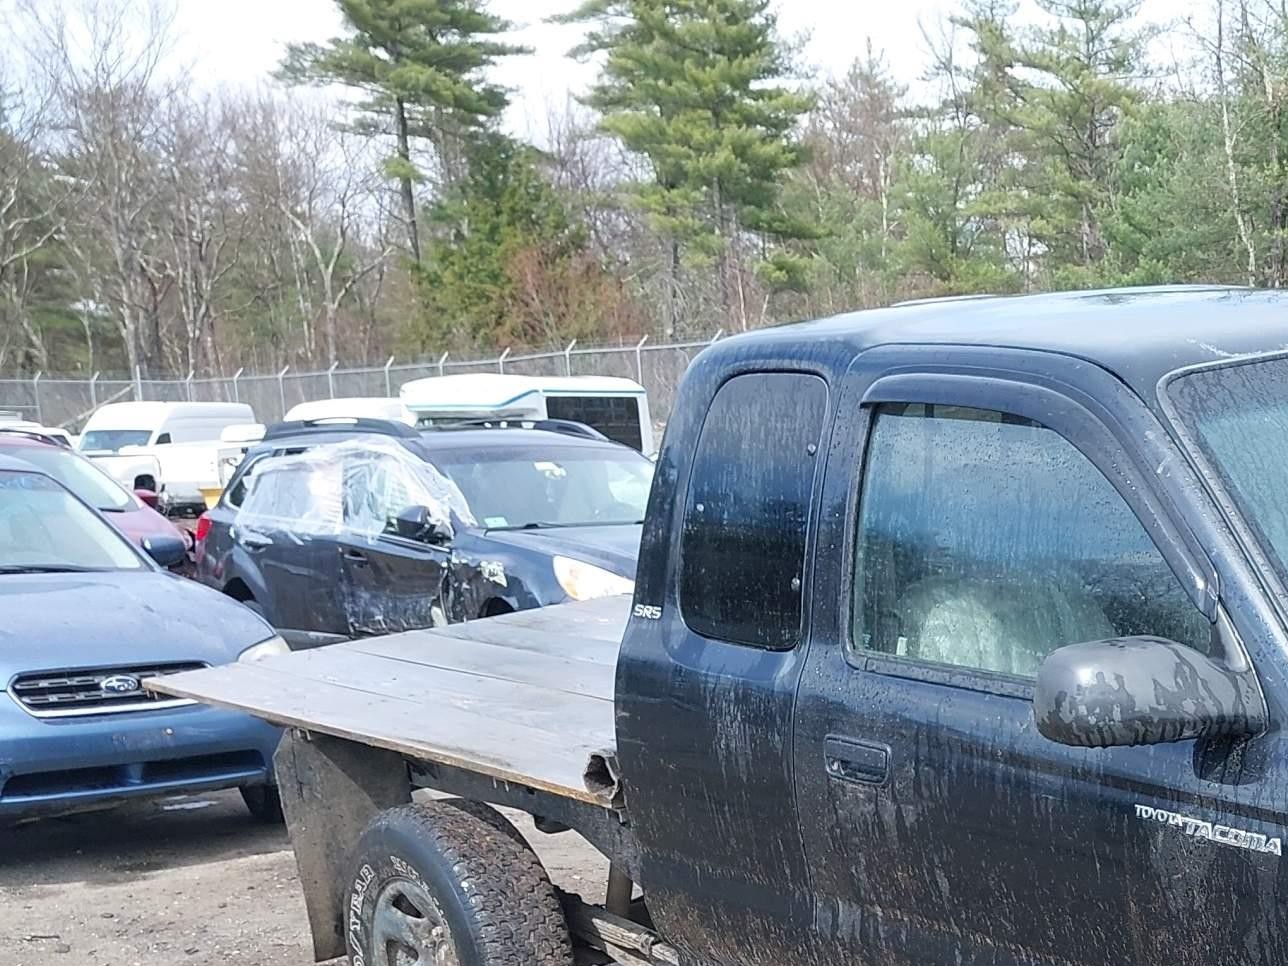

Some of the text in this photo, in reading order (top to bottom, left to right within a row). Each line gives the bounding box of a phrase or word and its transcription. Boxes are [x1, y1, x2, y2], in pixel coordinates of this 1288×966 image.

[633, 603, 662, 620] SR5
[1134, 804, 1282, 856] TOYOTA TACOMA
